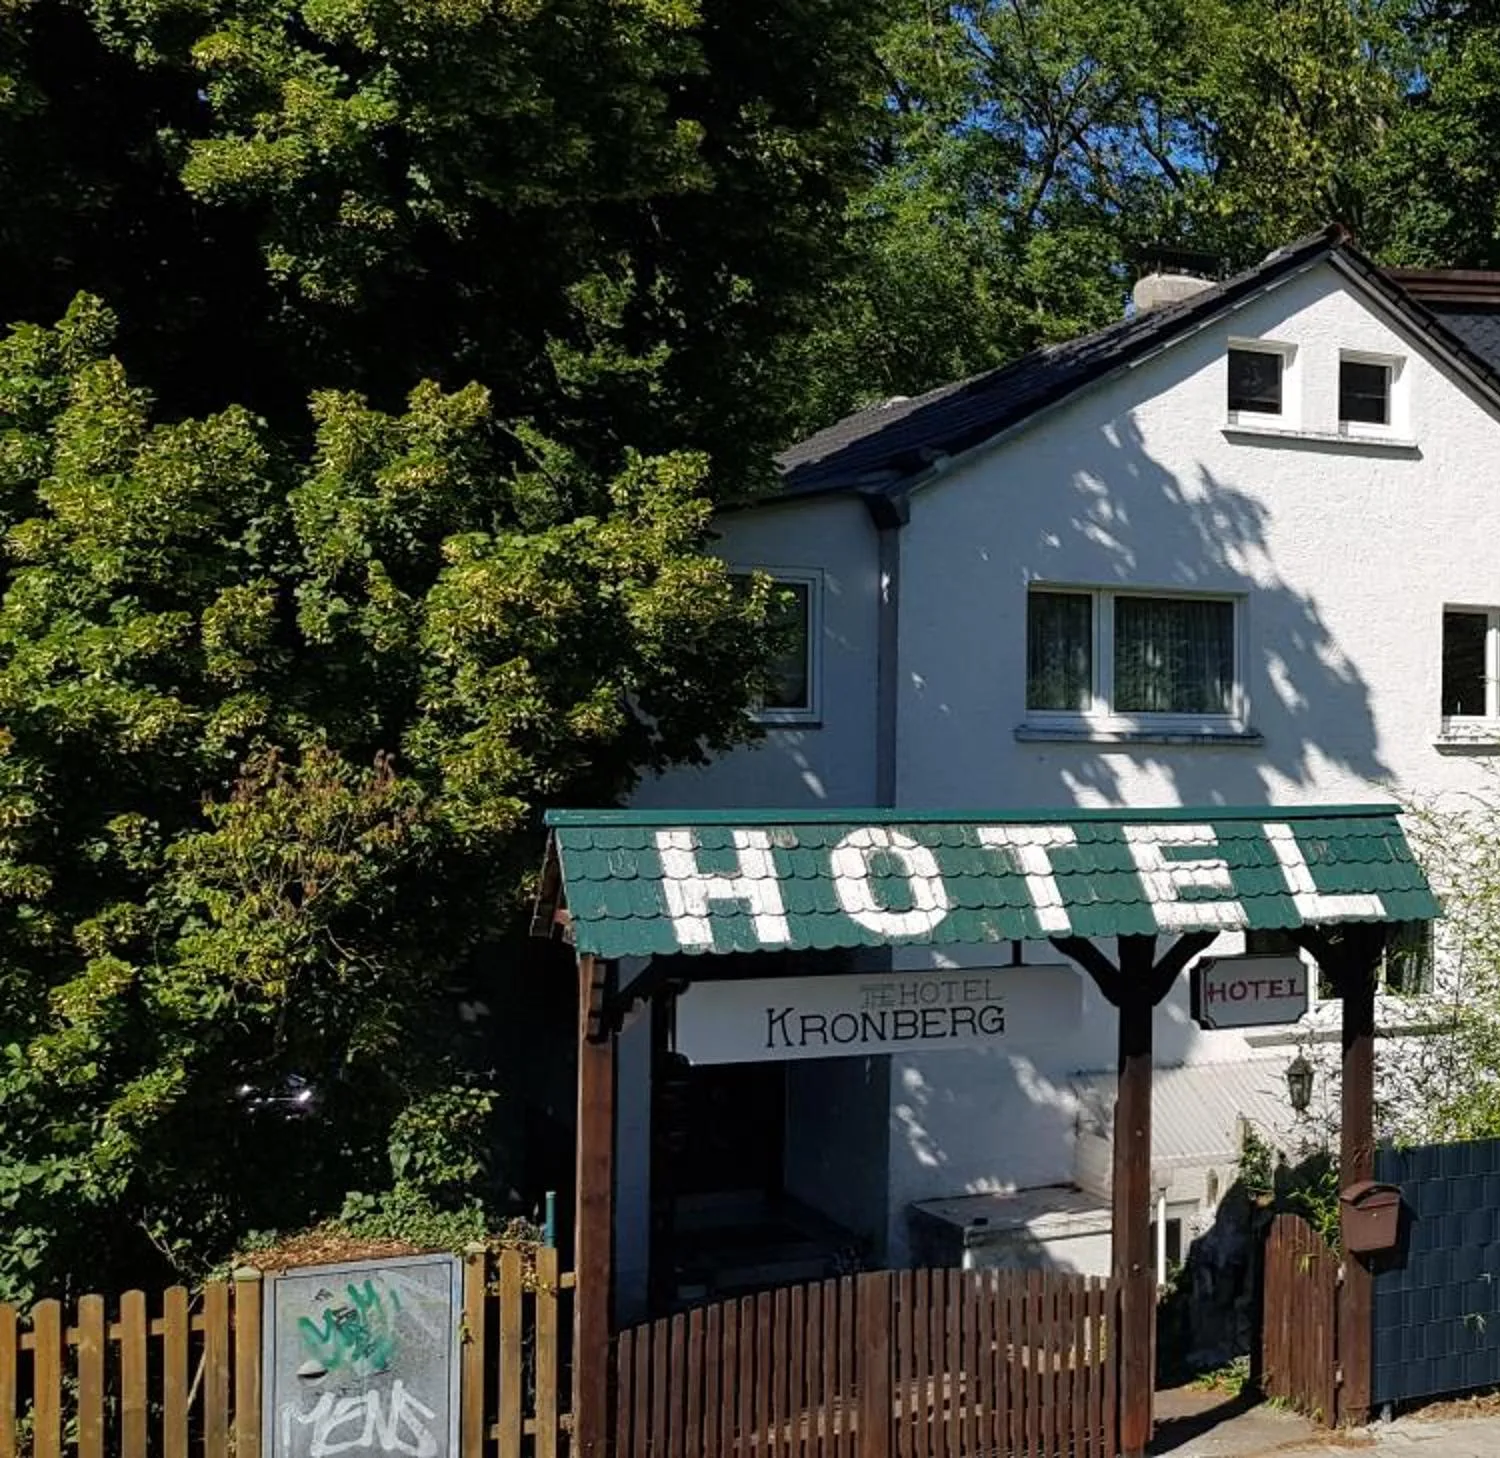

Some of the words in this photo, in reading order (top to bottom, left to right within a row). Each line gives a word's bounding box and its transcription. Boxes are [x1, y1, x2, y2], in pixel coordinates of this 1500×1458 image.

[655, 823, 1387, 945] HOTEL
[899, 978, 1004, 1005] HOTEL
[1207, 978, 1304, 1004] HOTEL
[766, 1004, 1005, 1048] KRONBERG
